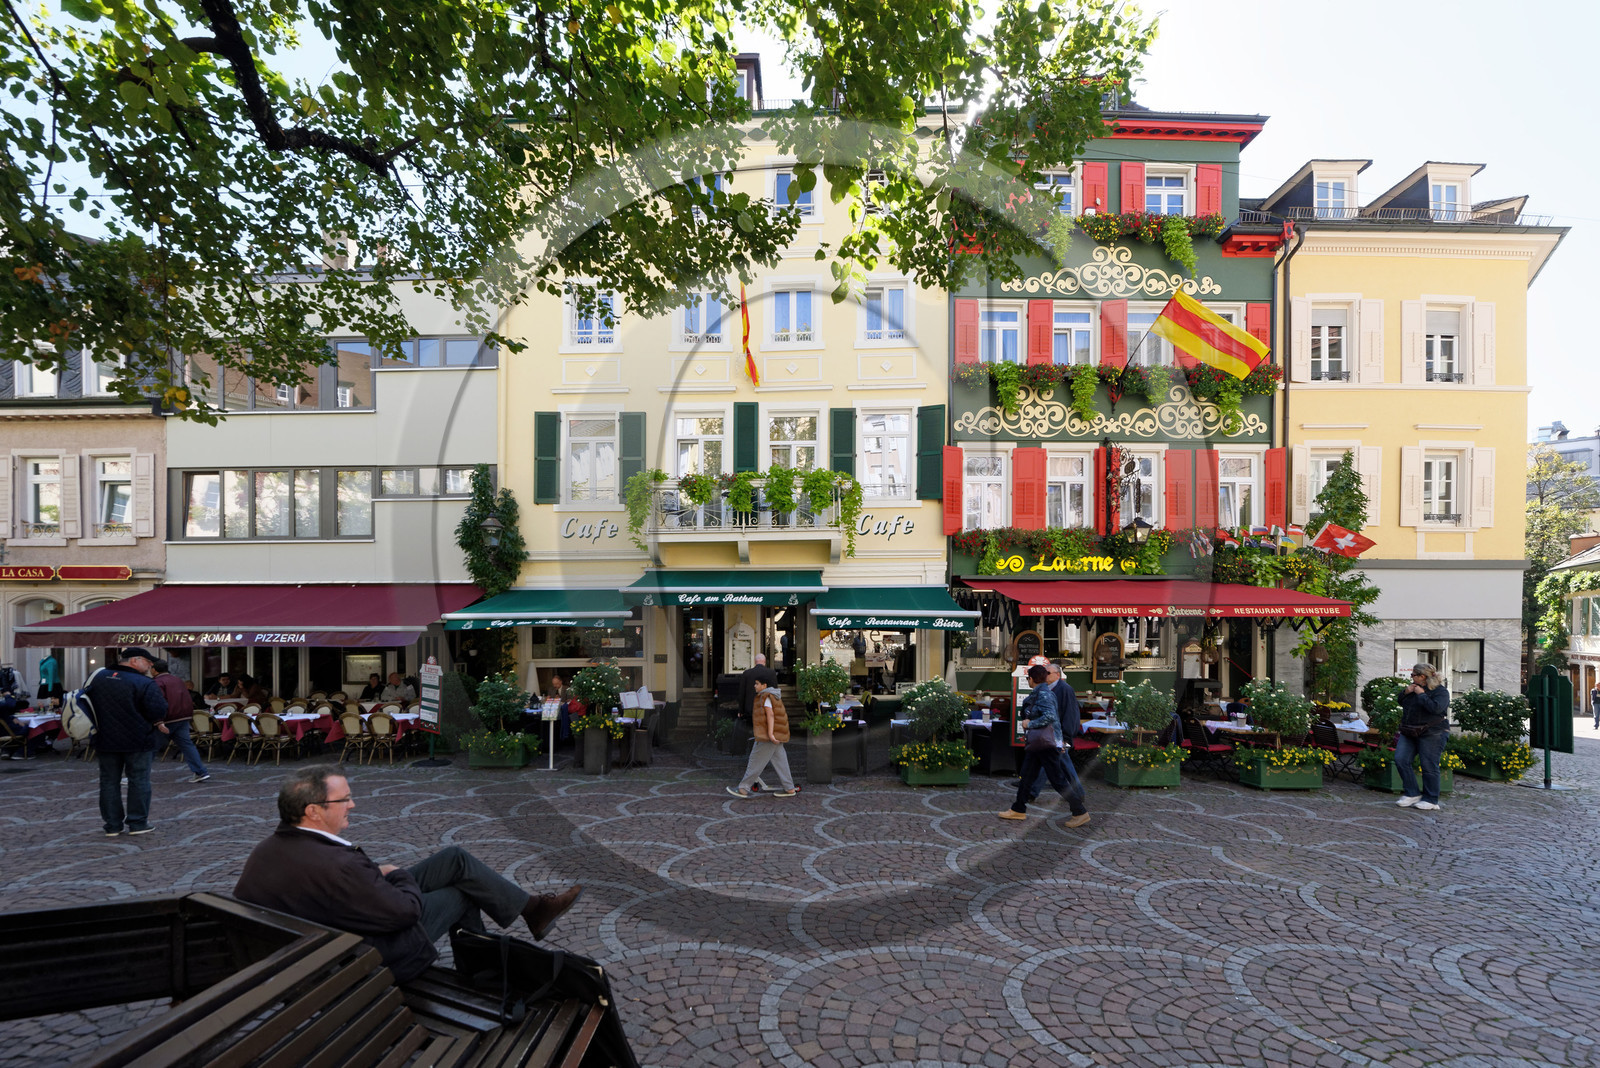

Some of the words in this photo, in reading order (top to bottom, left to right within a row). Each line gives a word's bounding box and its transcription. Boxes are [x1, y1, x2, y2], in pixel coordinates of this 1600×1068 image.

[561, 517, 618, 544] Cafe
[856, 513, 914, 541] Cafe
[2, 568, 15, 577] LA
[18, 568, 45, 577] CASA
[678, 594, 701, 604] Cafe
[722, 594, 763, 603] Rathaus
[1166, 605, 1206, 616] Laterne
[1293, 607, 1340, 615] WEINSTUBE
[827, 617, 852, 628] Cafe
[865, 617, 920, 626] Restaurant
[932, 618, 964, 628] Bistro
[117, 633, 189, 643] RISTORANTE
[200, 633, 231, 643] ROMA
[254, 633, 306, 643] PIZZERIA
